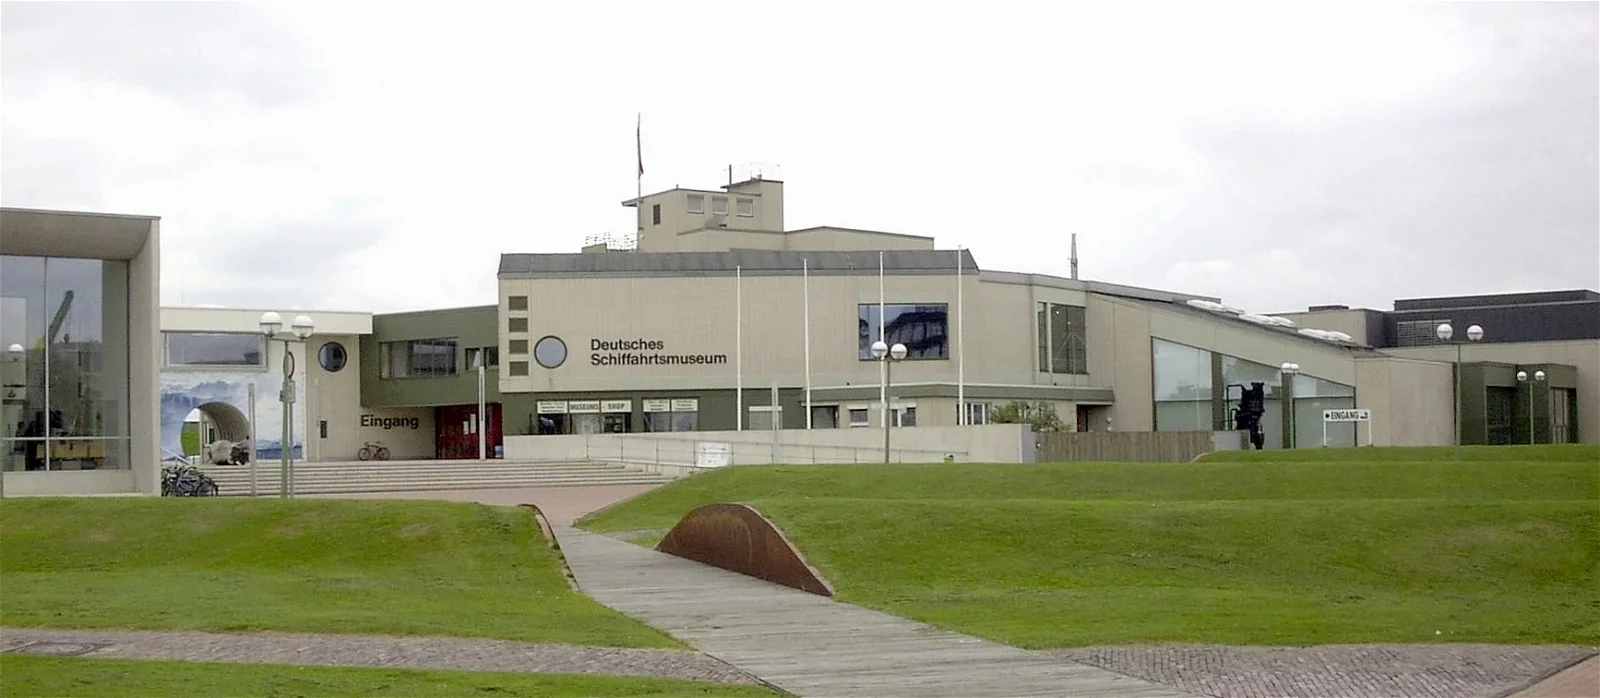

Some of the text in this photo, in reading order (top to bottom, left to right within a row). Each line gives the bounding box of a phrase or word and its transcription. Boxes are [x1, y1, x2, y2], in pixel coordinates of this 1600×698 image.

[590, 338, 664, 350] Deutsches
[590, 353, 727, 366] Schiffahrtsmuseum
[1331, 411, 1359, 420] EINGANG
[360, 414, 419, 430] Eingang
